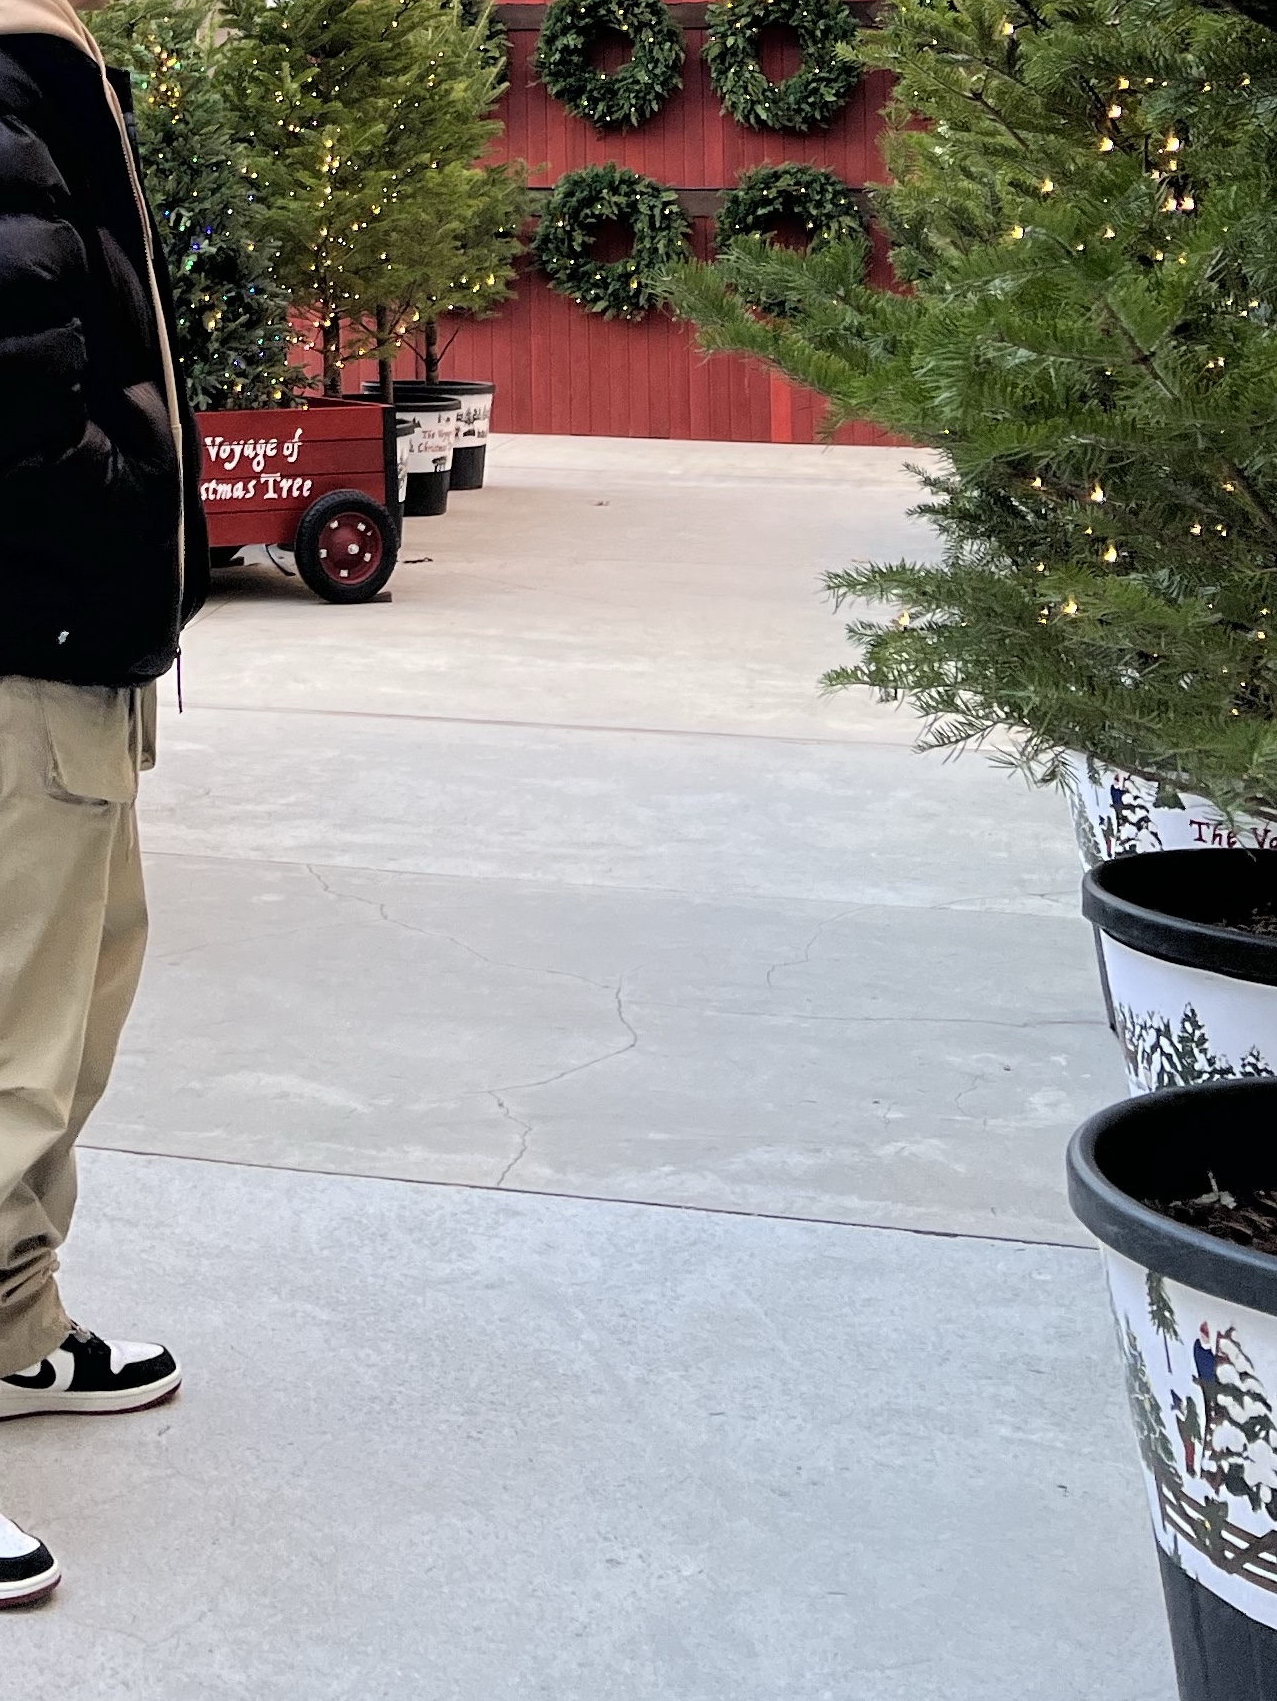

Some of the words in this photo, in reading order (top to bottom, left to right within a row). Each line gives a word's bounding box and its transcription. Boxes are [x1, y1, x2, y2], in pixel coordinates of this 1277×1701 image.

[204, 436, 278, 473] Voyage
[283, 427, 303, 463] of
[200, 479, 257, 501] stmas
[260, 472, 313, 500] Tree
[1189, 819, 1237, 848] The
